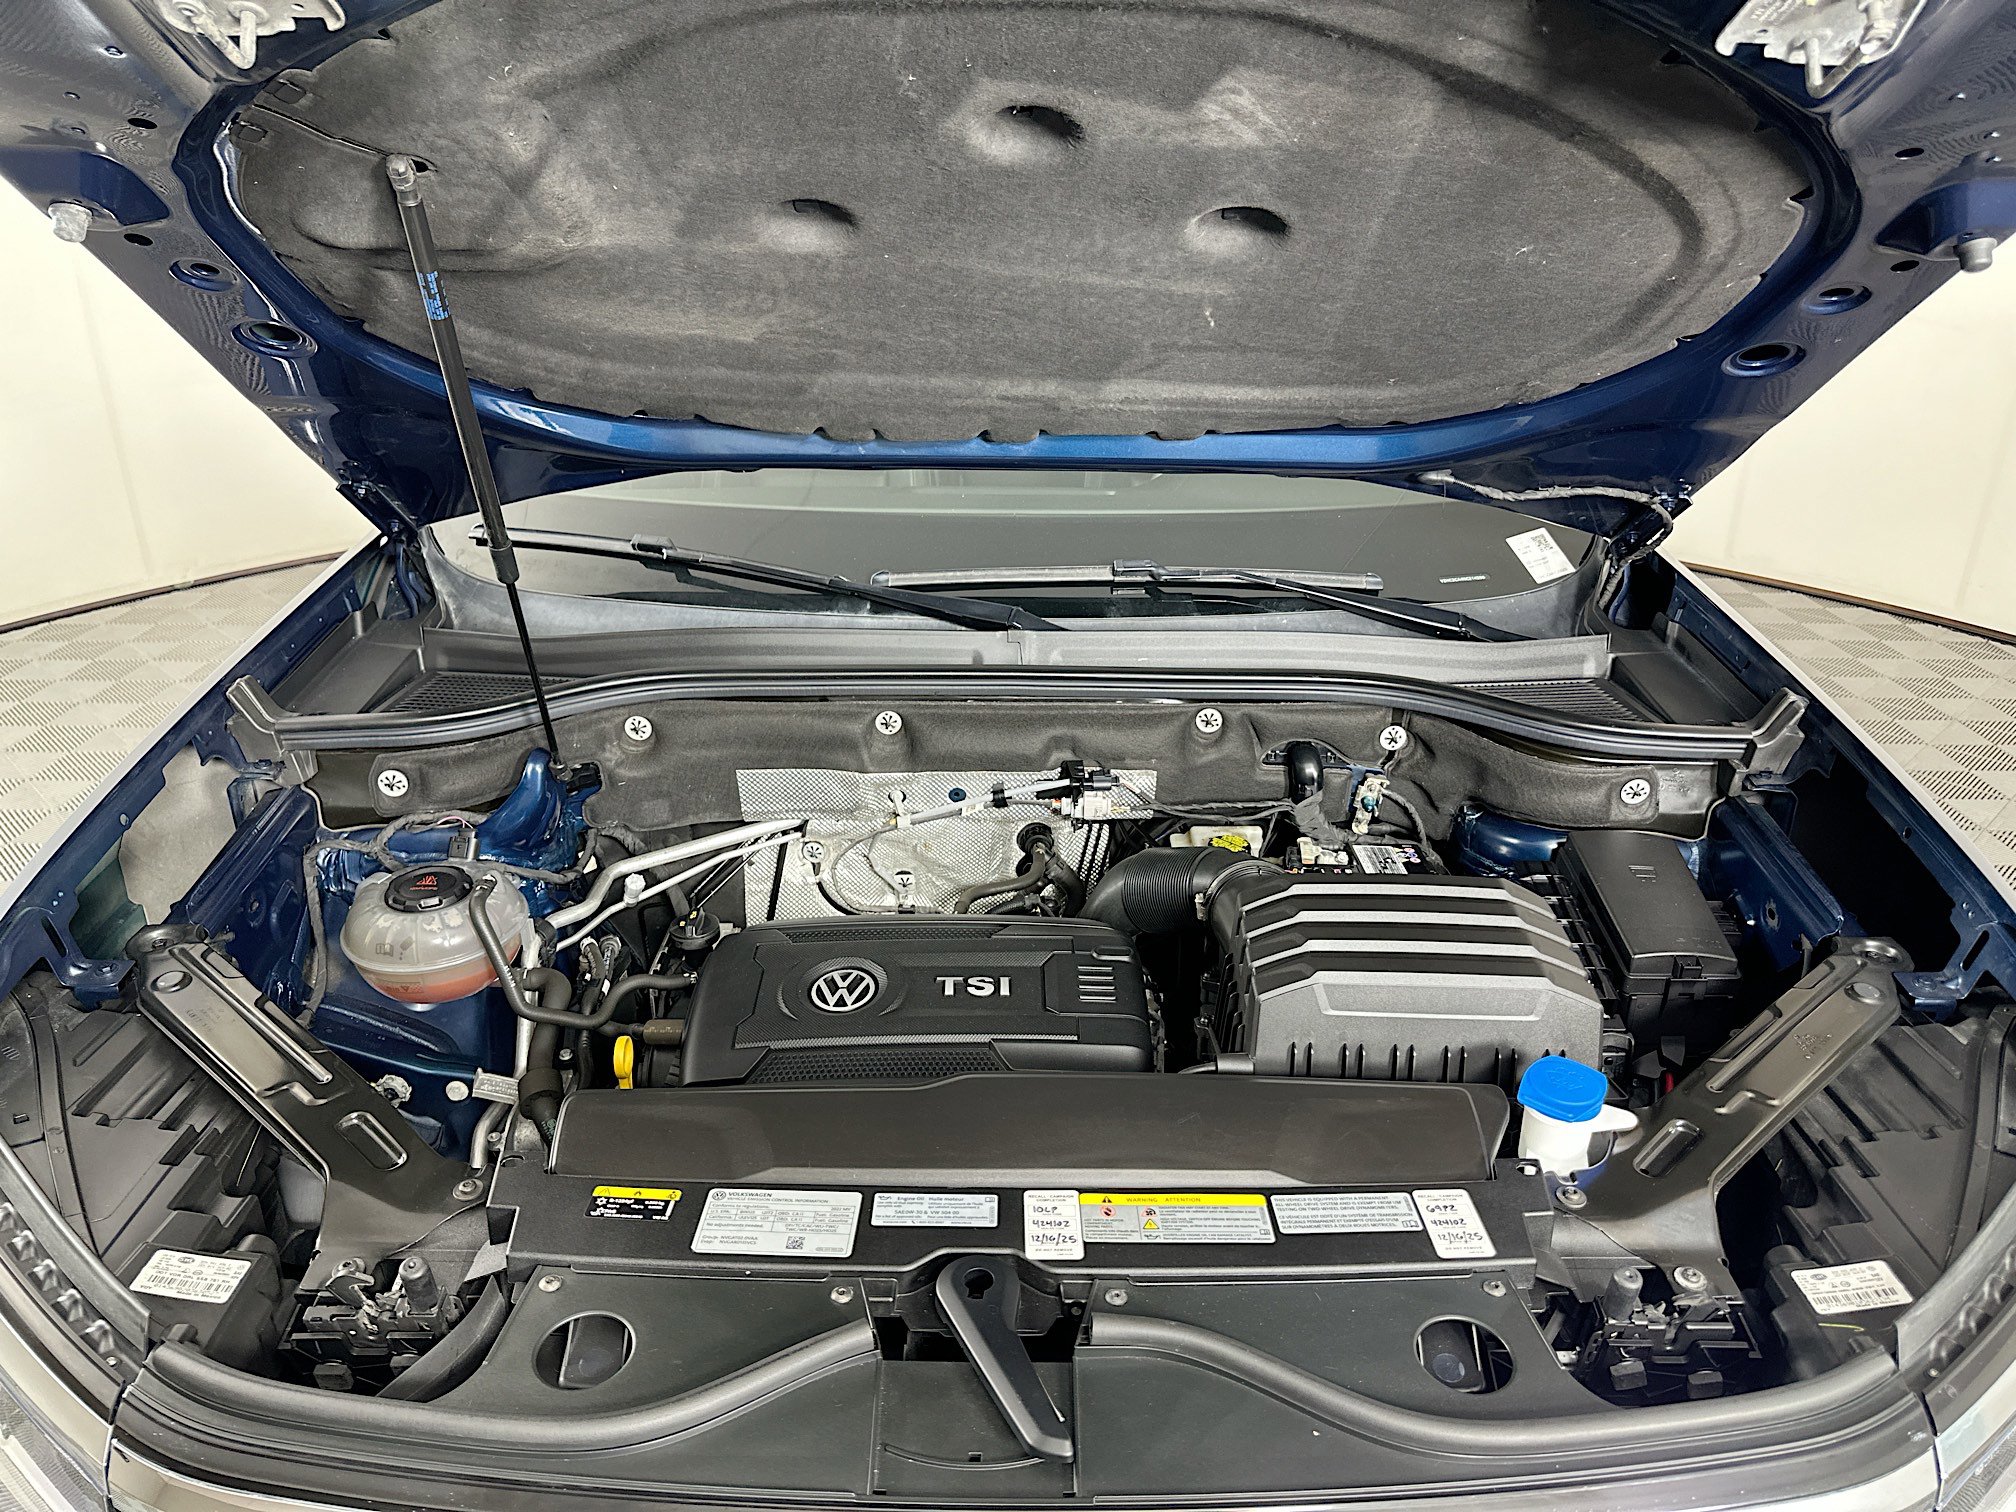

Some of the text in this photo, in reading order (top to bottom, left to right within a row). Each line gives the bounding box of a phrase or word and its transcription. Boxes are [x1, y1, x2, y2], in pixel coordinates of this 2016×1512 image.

[934, 975, 1012, 997] TSI
[1032, 1219, 1070, 1228] 424102
[1430, 1218, 1467, 1226] 424102
[1031, 1232, 1077, 1246] 12/16/25
[1438, 1230, 1484, 1244] 12/16/25
